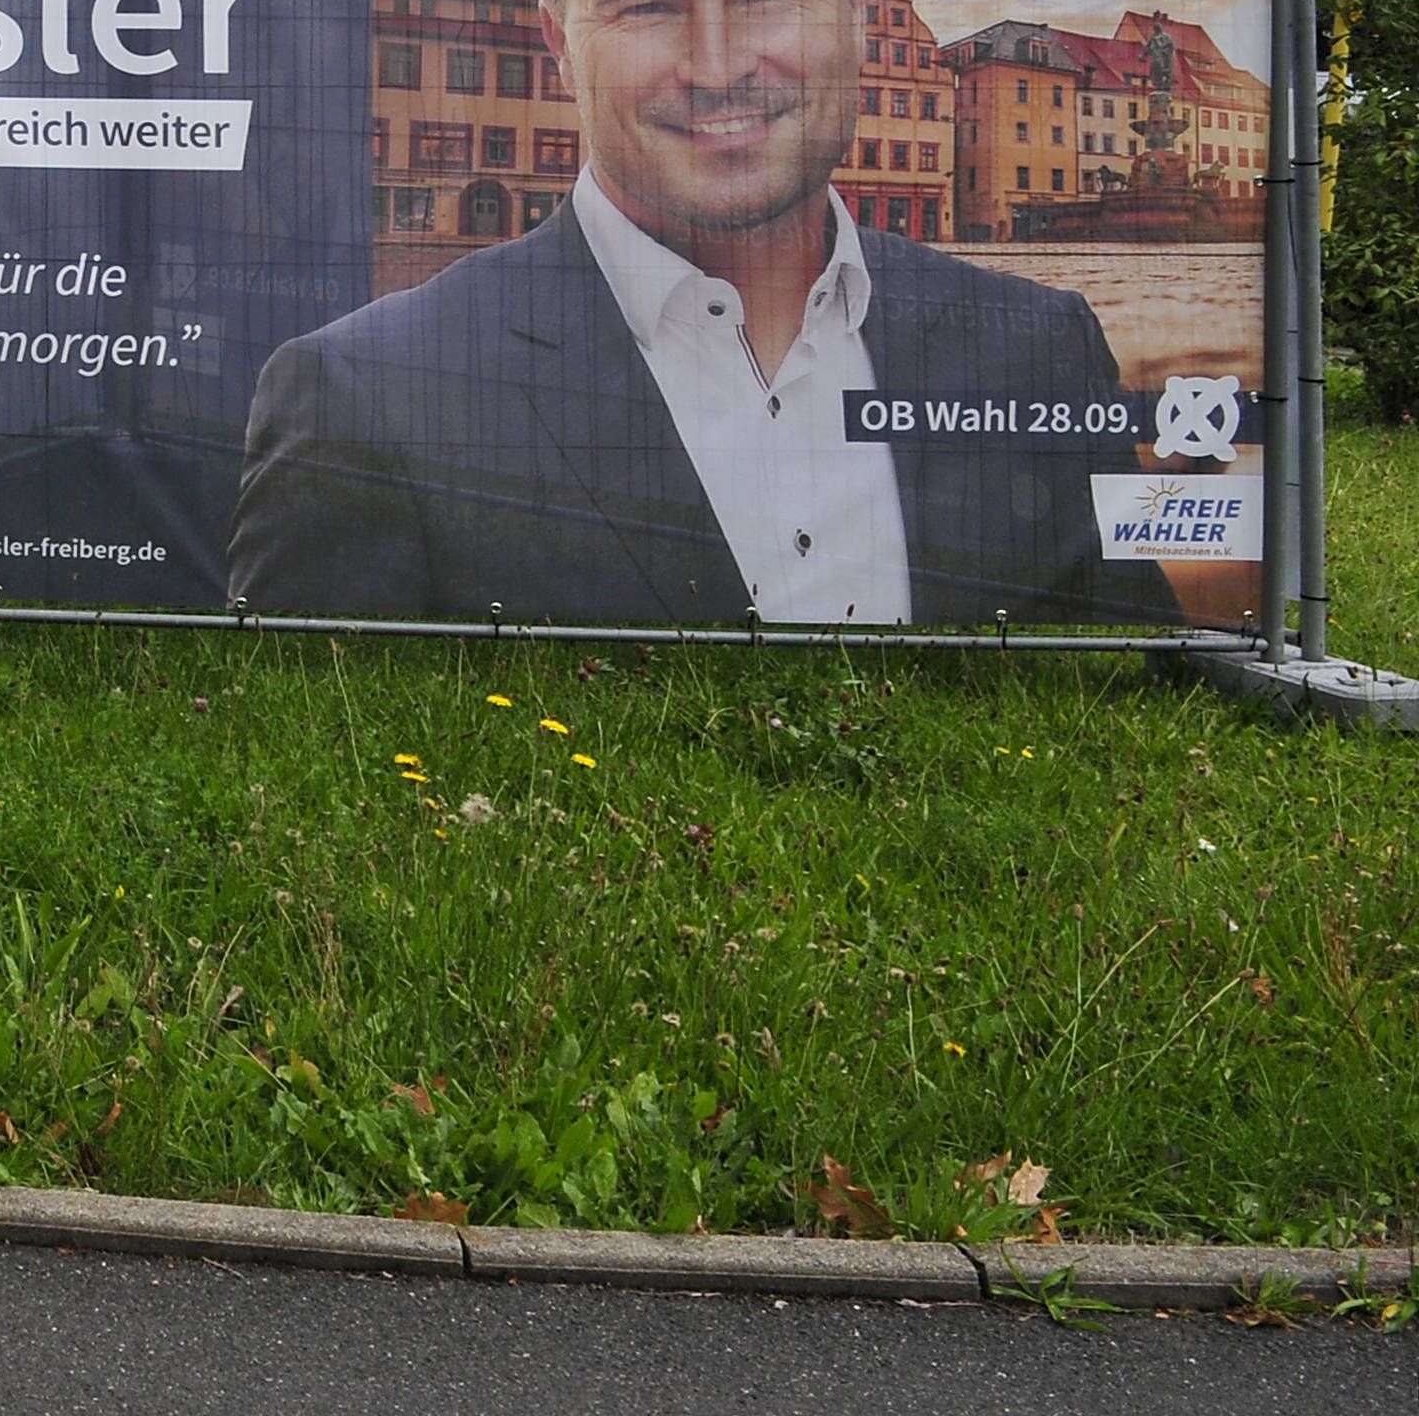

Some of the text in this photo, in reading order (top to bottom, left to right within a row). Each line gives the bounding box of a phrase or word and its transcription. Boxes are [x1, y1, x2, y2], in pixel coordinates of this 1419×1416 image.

[101, 112, 230, 149] weiter
[55, 253, 127, 298] die
[861, 400, 1140, 434] OB Wahl 28.09.
[1162, 499, 1242, 518] FREIE
[1114, 519, 1226, 541] WÄHLER
[1134, 546, 1232, 556] Mittelsachsen e.V.
